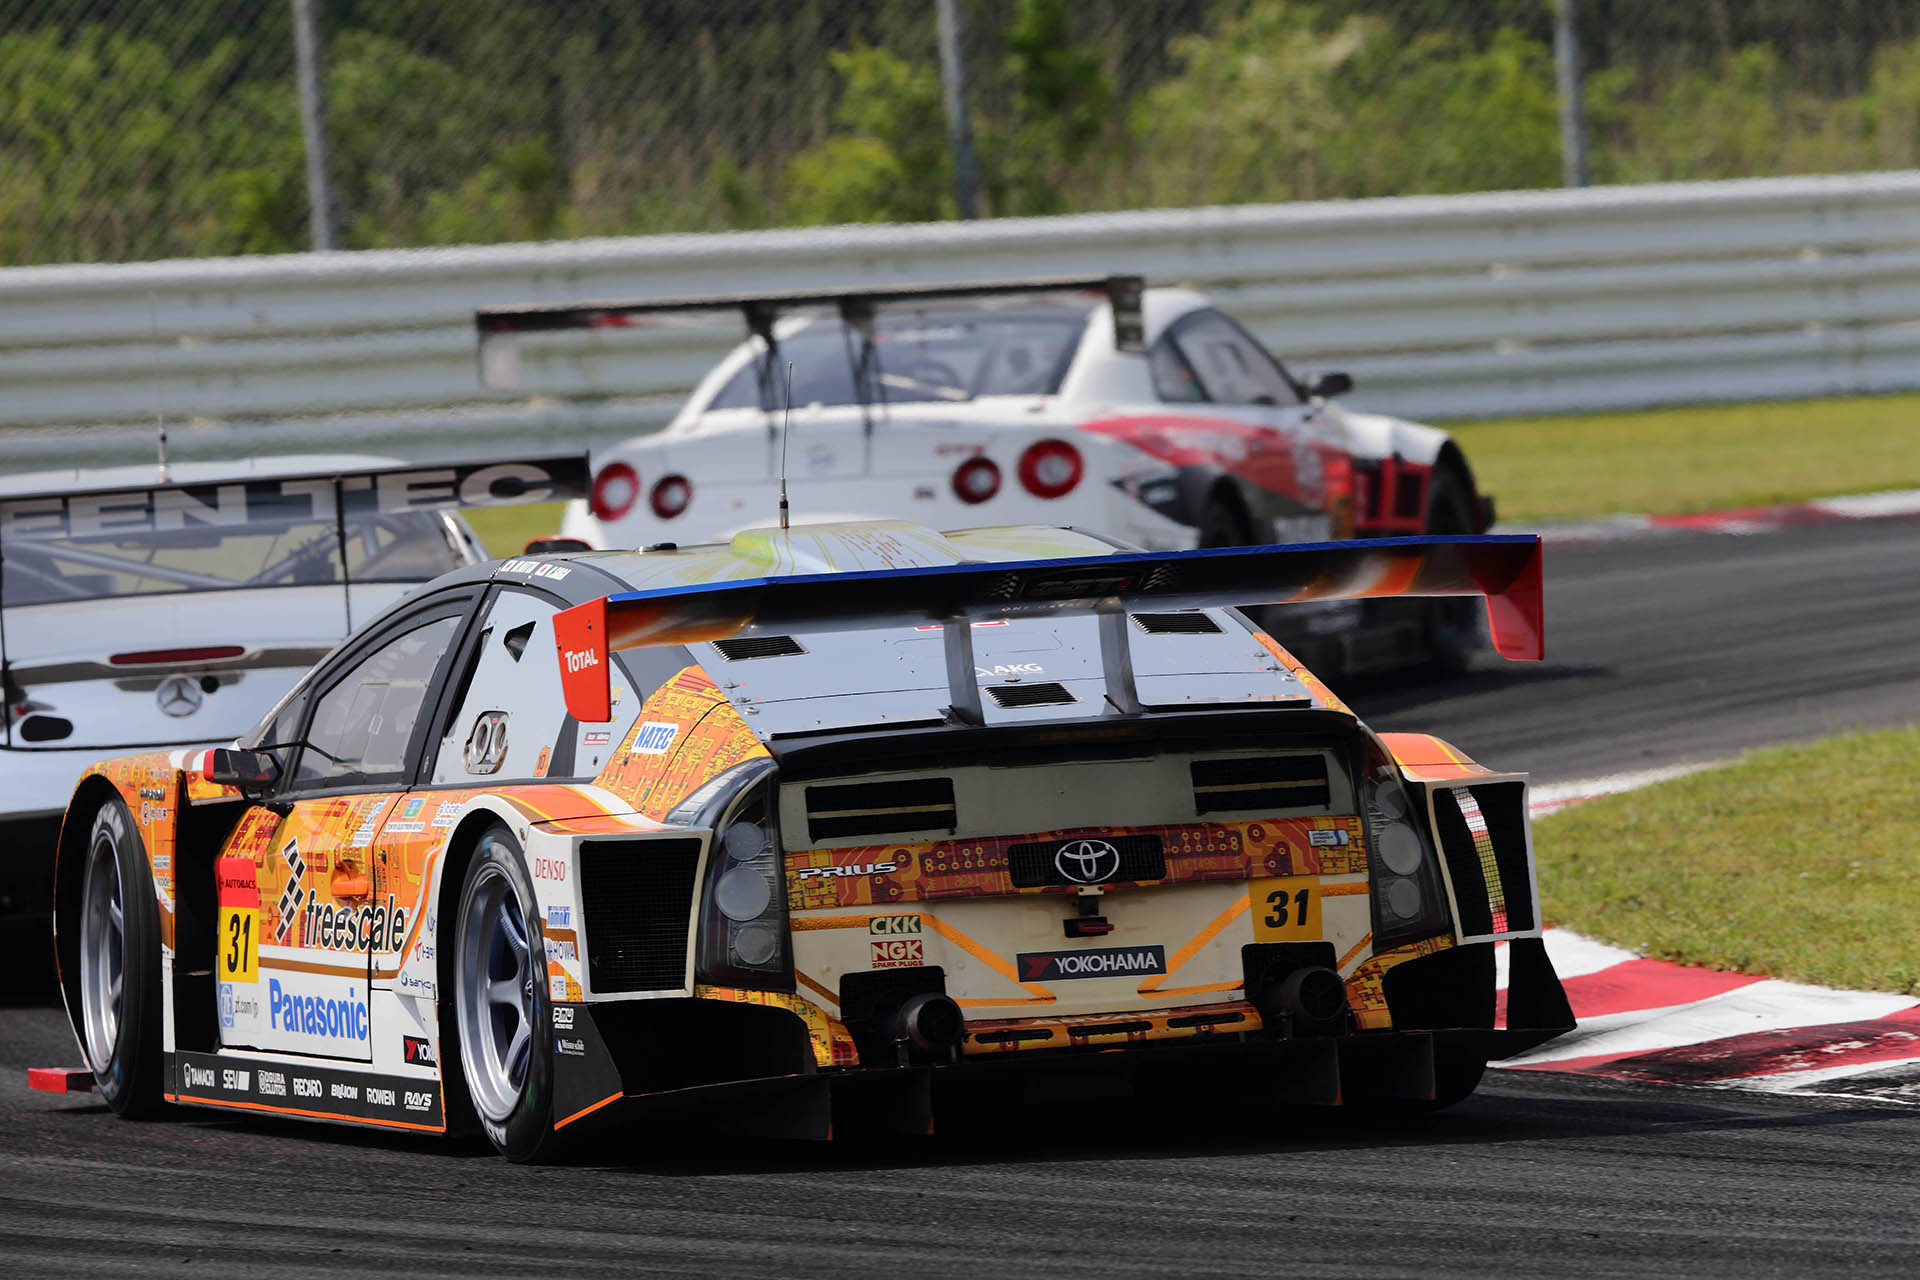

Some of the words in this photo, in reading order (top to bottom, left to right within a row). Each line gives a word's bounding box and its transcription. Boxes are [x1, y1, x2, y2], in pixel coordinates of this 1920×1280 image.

[564, 648, 599, 673] TOTAL
[993, 663, 1044, 673] AKG
[634, 725, 676, 750] NATEC
[535, 858, 566, 881] DENSO
[799, 861, 898, 880] PRIUS
[225, 879, 256, 890] AUTOBACS
[1264, 888, 1309, 929] 31
[305, 888, 405, 953] freescale
[870, 917, 919, 934] CKK
[227, 913, 251, 973] 31
[871, 940, 923, 962] NGK
[1054, 951, 1158, 974] YOKOHAMA
[269, 978, 368, 1041] Panasonic
[191, 1067, 215, 1087] TAMACHI
[293, 1077, 323, 1098] RECARO
[366, 1087, 396, 1106] ROWEN
[404, 1091, 433, 1107] RAYS
